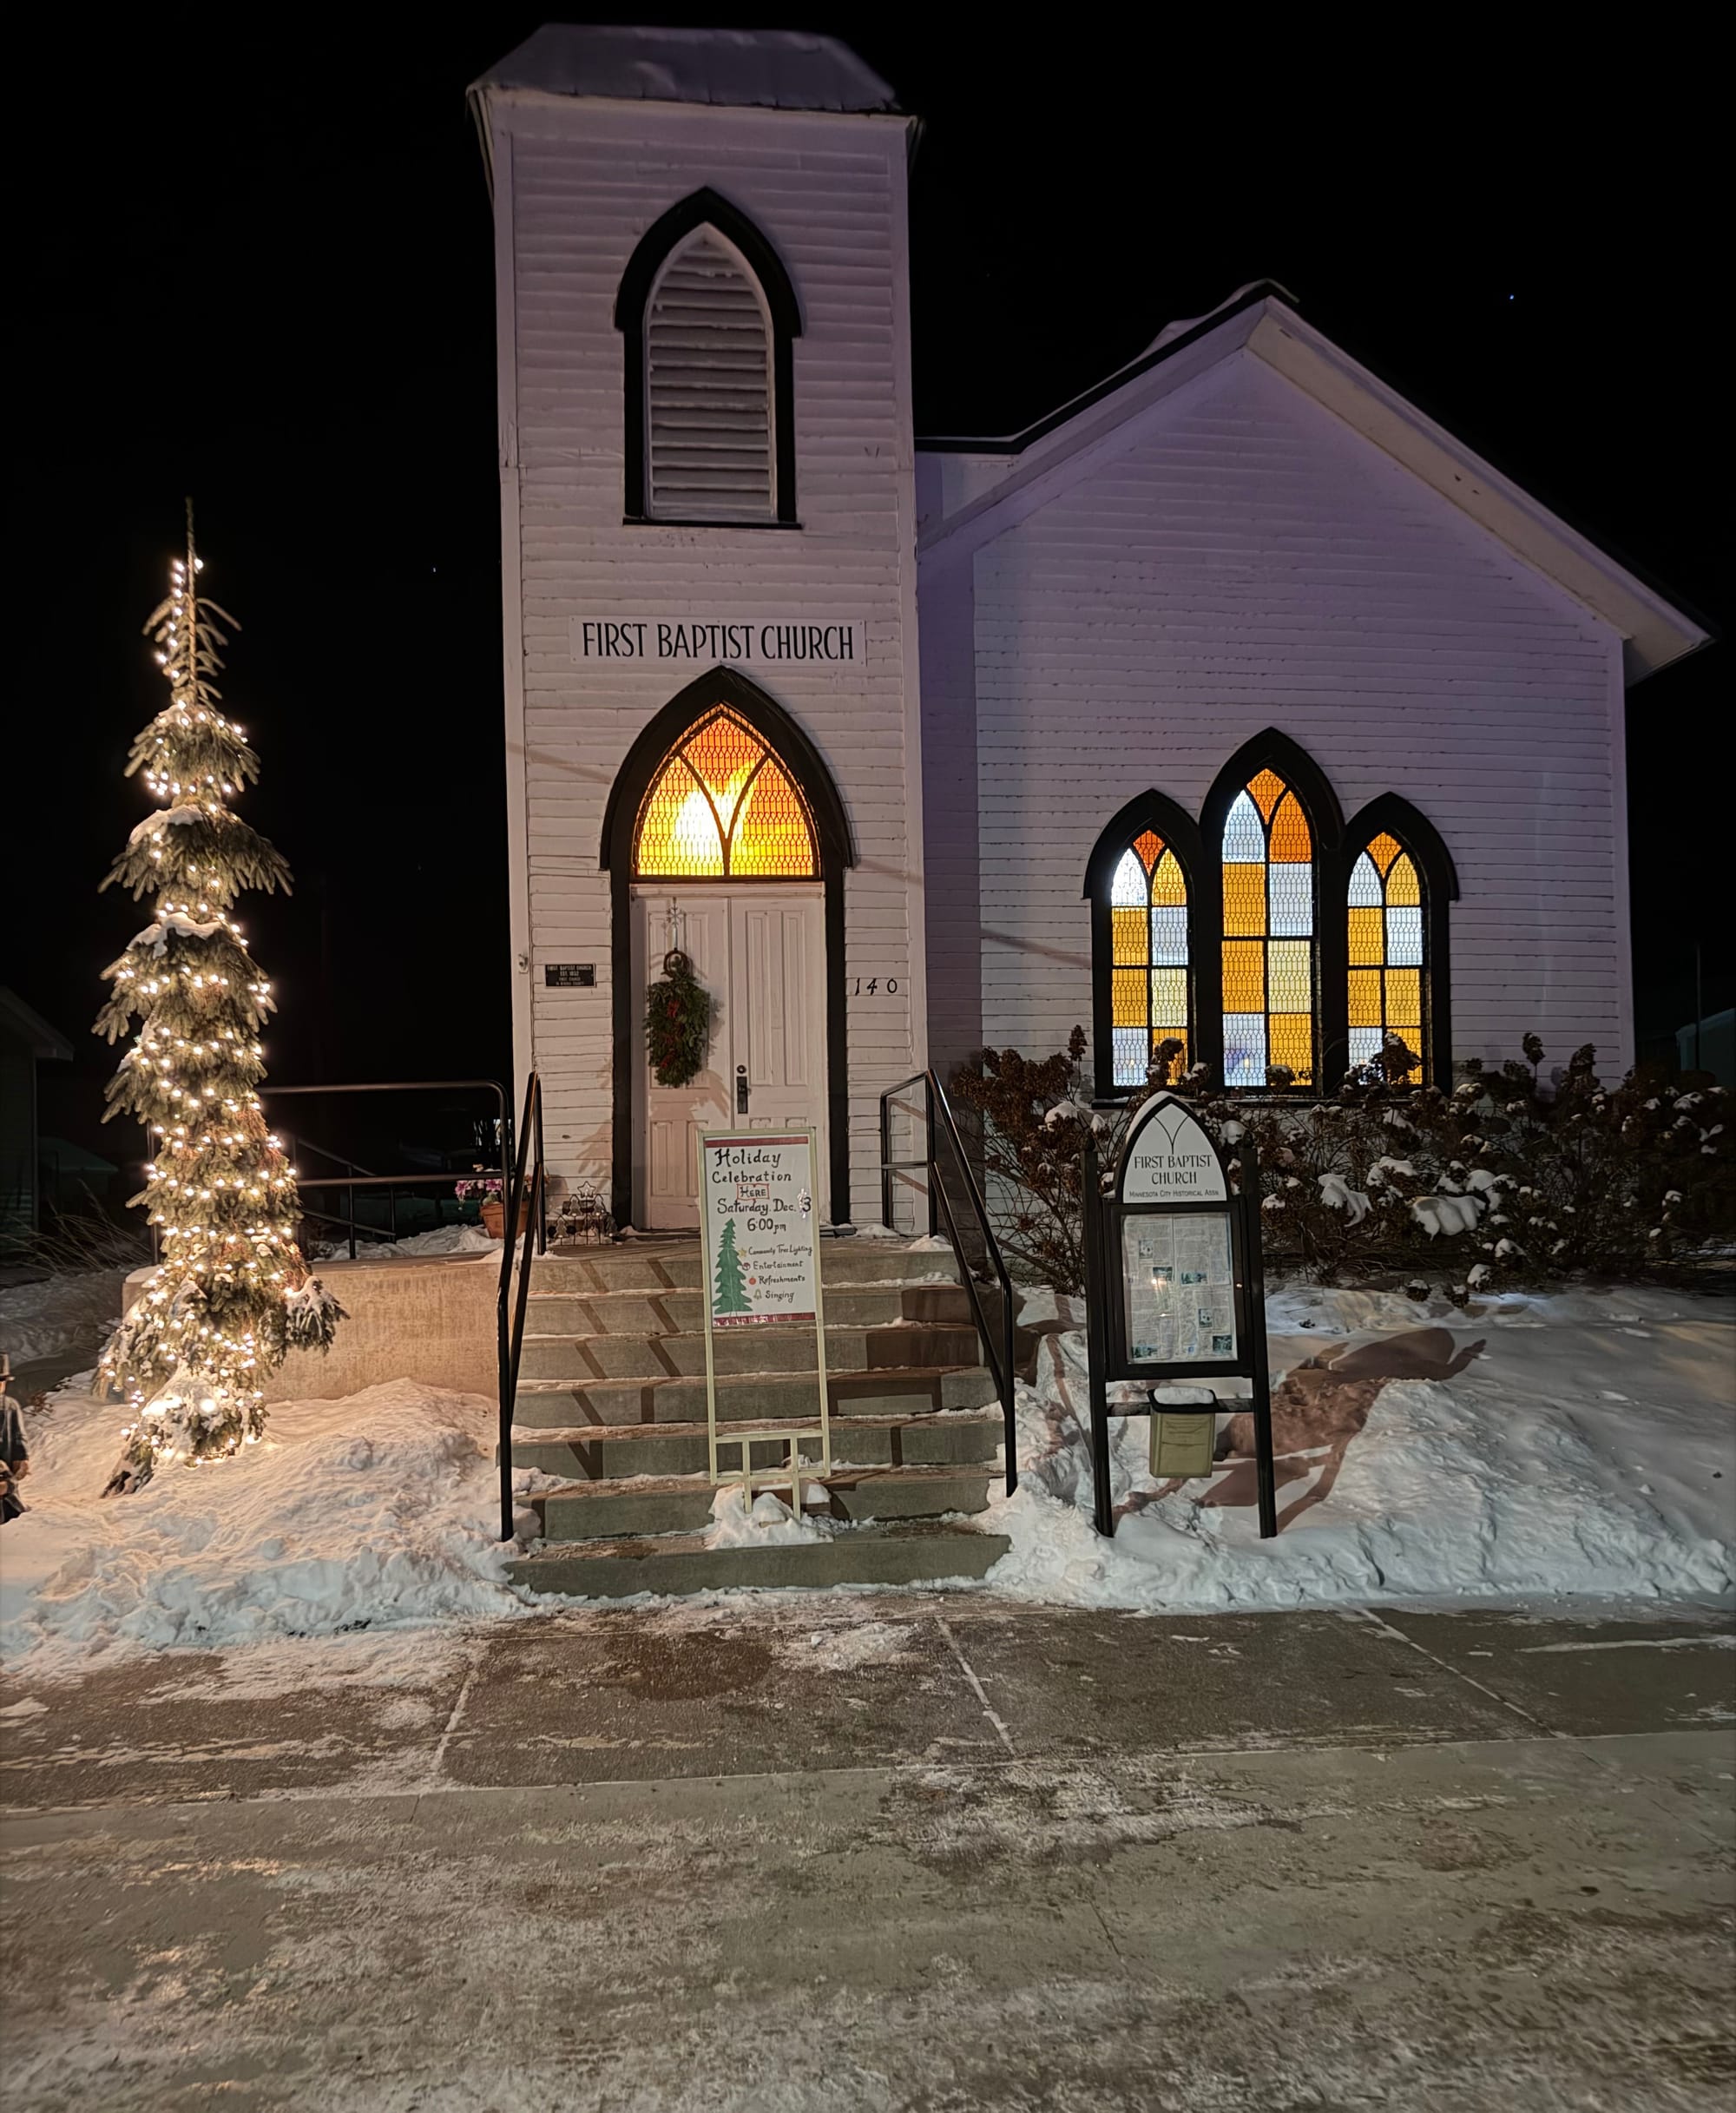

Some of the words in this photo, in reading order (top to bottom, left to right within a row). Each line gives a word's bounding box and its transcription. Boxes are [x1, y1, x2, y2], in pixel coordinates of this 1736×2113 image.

[582, 622, 648, 657] FIRST
[657, 623, 755, 660] BAPTIST
[760, 625, 854, 661] CHURCH
[855, 978, 898, 996] 140
[714, 1148, 781, 1168] Holiday
[1134, 1155, 1164, 1169] FIRST
[1167, 1154, 1213, 1168] BAPTIST
[712, 1170, 792, 1184] Celebration
[1151, 1171, 1197, 1185] CHURCH
[740, 1186, 766, 1197] HERE
[773, 1198, 797, 1213] Dec.
[777, 1243, 789, 1254] Tree
[789, 1244, 812, 1257] Lighting
[753, 1261, 804, 1270] Entertainment
[758, 1274, 806, 1285] Refreshments
[765, 1290, 795, 1303] Singing
